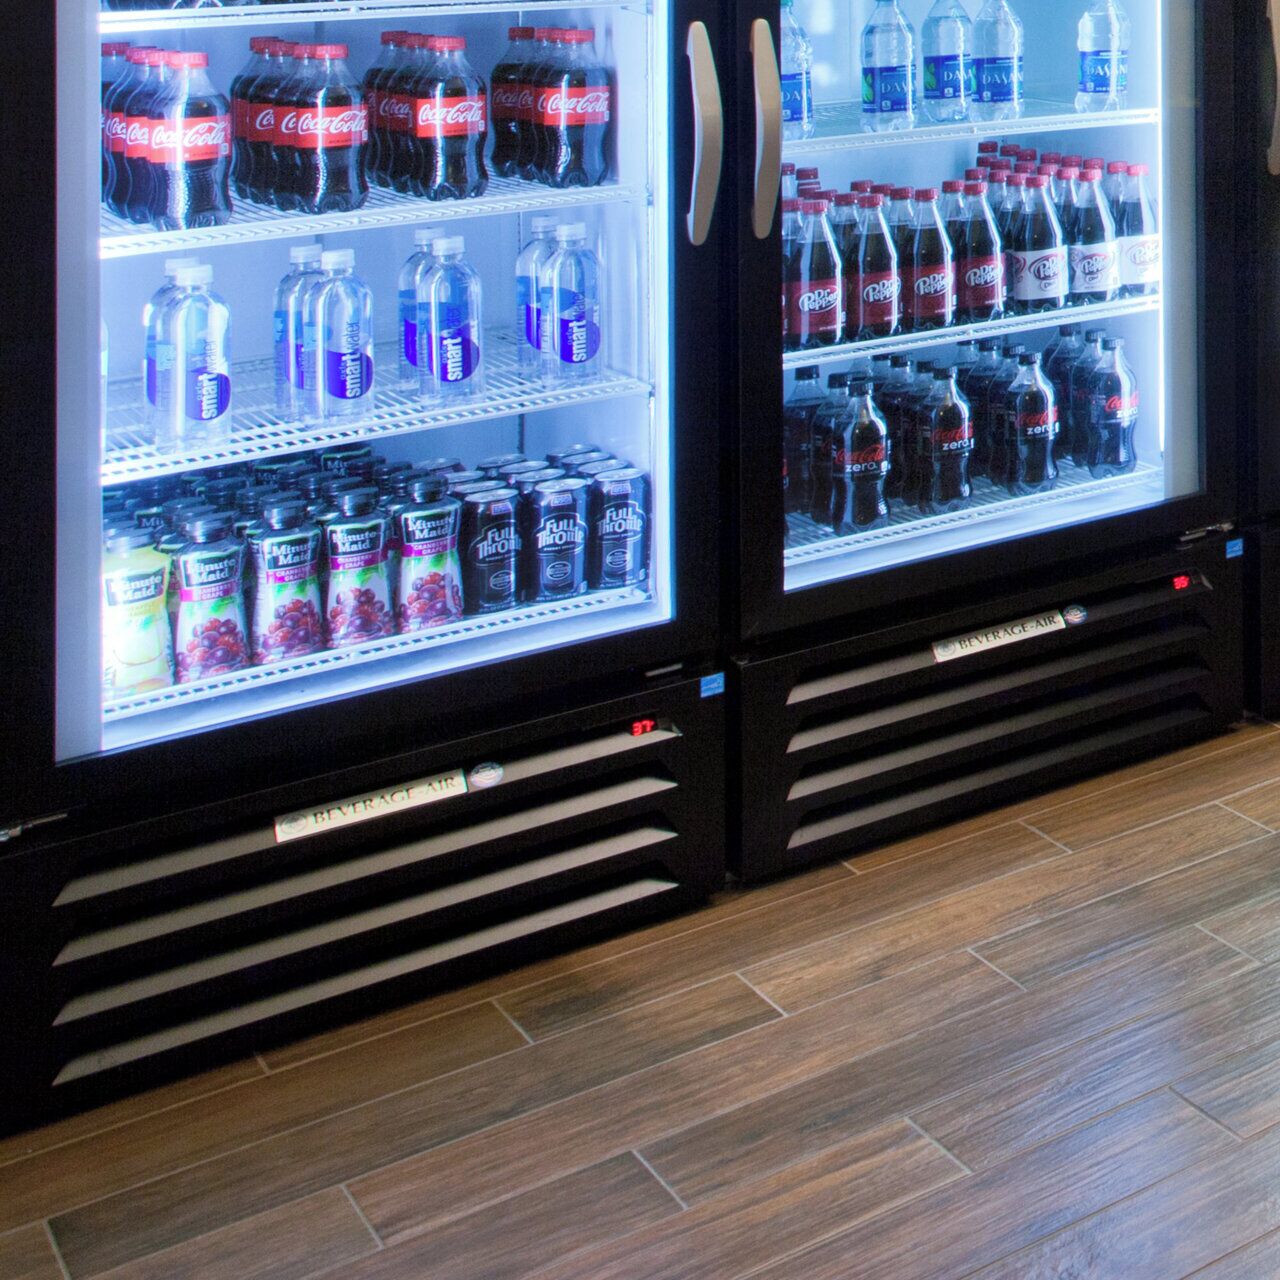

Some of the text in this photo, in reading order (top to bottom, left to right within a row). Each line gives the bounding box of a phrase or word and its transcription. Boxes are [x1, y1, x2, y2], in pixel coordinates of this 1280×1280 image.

[418, 101, 484, 125] Coca-Cola
[547, 91, 610, 114] Coca-Cola
[298, 109, 367, 135] Coca-Cola
[151, 120, 227, 149] Coca-Cola
[845, 460, 878, 473] zero
[606, 506, 634, 521] Full
[545, 518, 575, 534] Full
[958, 614, 1058, 651] BEVERAGE-AIR
[312, 775, 459, 826] BEVERAGE-AIR
